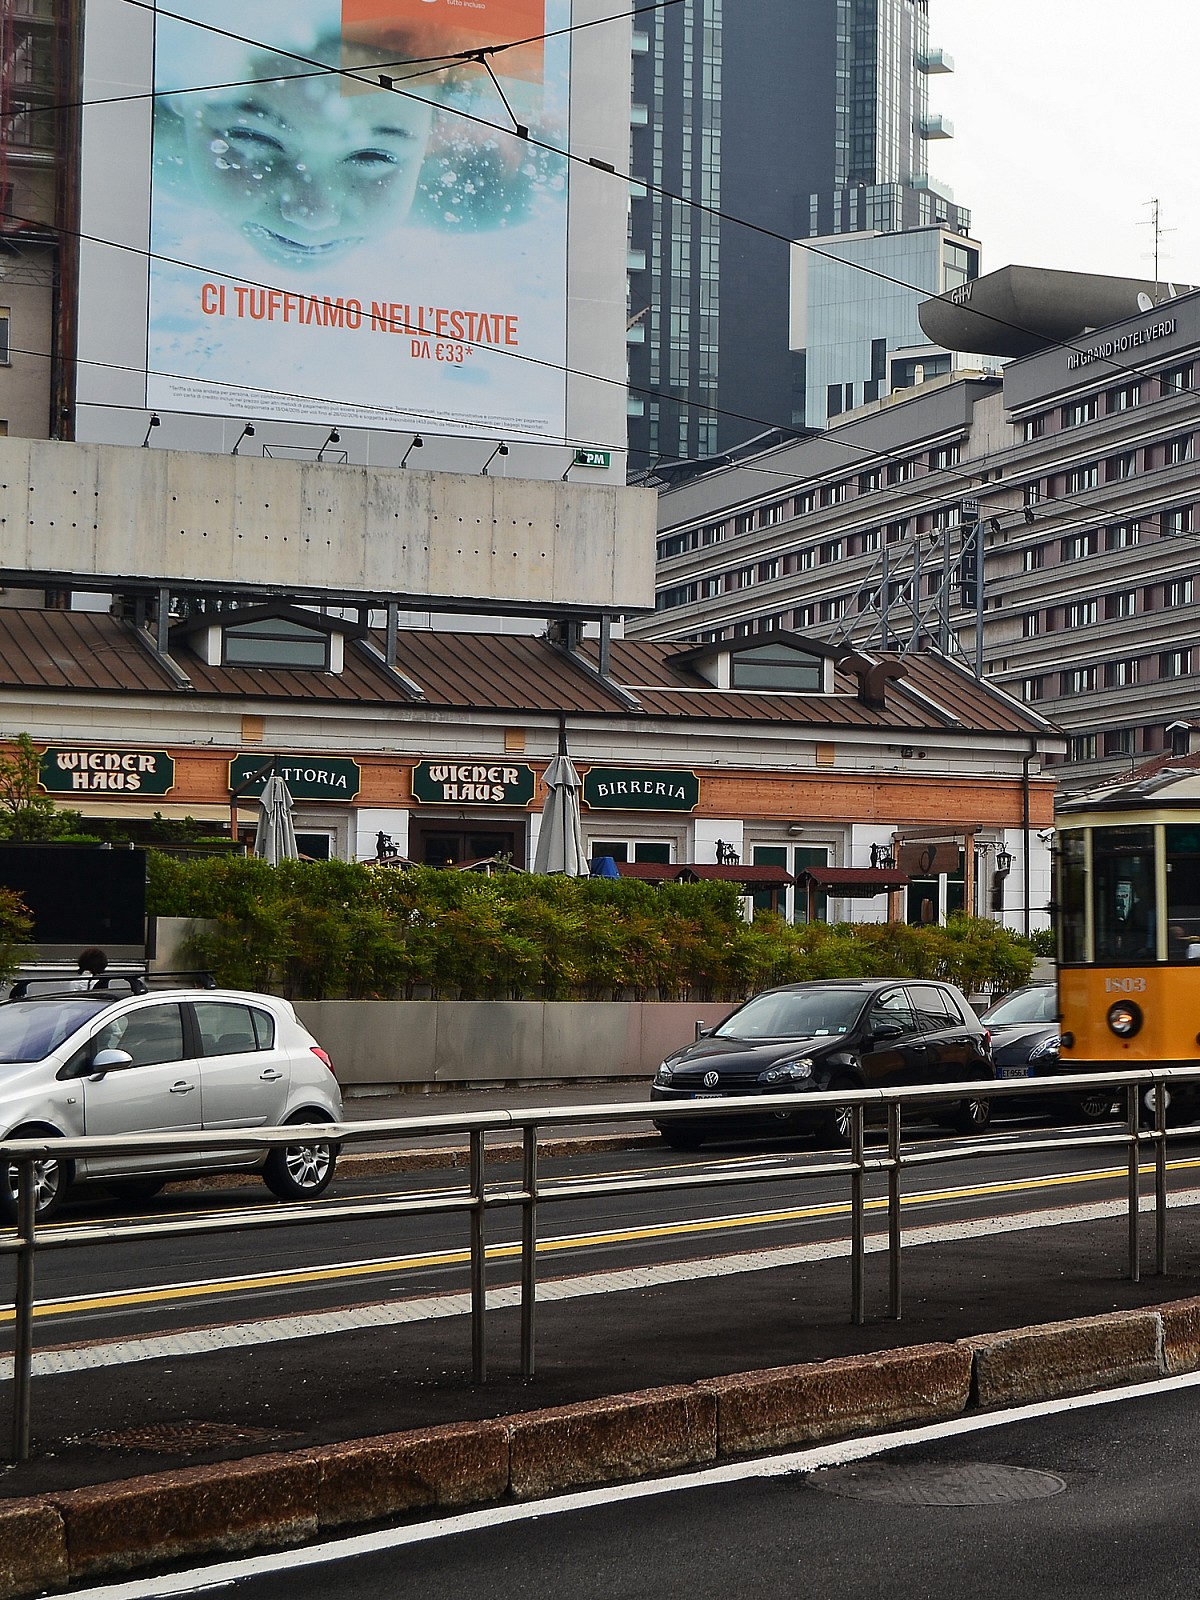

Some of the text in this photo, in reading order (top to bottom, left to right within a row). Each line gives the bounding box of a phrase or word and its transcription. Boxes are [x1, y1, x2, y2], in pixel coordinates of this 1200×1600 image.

[201, 283, 518, 346] CI TUFFIAMO NELL'ESTATE
[411, 340, 430, 360] DA
[1081, 342, 1112, 366] GRAND
[1114, 331, 1144, 353] HOTEL
[1146, 318, 1176, 342] VERDI
[57, 752, 156, 773] WIENER
[72, 772, 141, 790] HAUS
[429, 766, 519, 785] WIENER
[443, 784, 505, 802] HAUS
[598, 781, 685, 800] BIRRERIA
